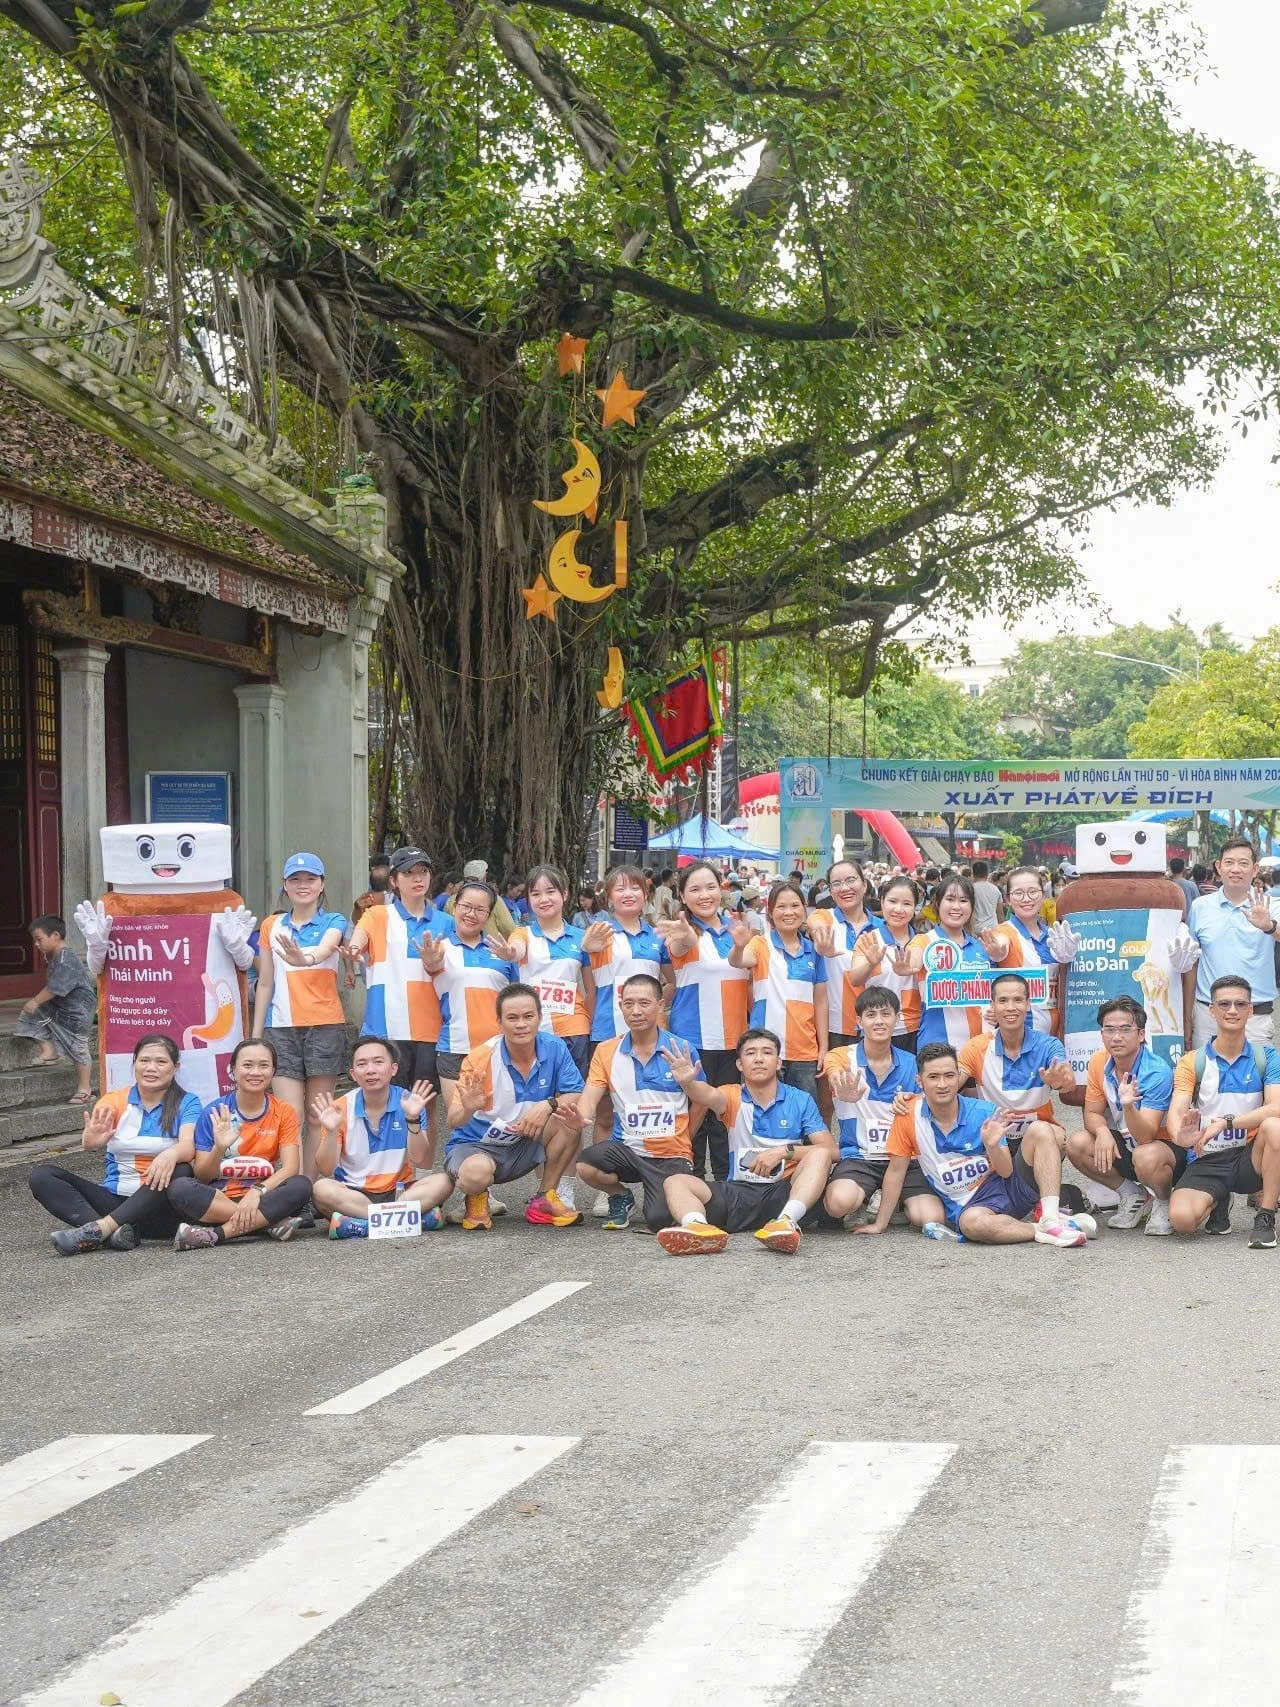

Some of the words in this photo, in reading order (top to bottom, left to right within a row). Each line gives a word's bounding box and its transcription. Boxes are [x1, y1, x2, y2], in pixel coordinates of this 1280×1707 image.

[862, 769, 896, 782] CHUNG
[899, 767, 918, 781] KẾT
[921, 767, 941, 782] GIẢI
[944, 769, 970, 785] CHẠY
[974, 768, 994, 782] BÁO
[1064, 768, 1080, 782] MỞ
[1083, 768, 1109, 785] RỘNG
[1112, 766, 1131, 782] LẦN
[1157, 770, 1169, 782] 50
[1192, 768, 1210, 781] HÒA
[1214, 768, 1237, 781] BÌNH
[1240, 769, 1262, 781] NĂM
[944, 785, 1014, 805] XUẤT
[1147, 786, 1213, 804] ĐÍCH
[794, 858, 804, 871] 71
[108, 938, 153, 961] Bình
[160, 937, 191, 965] Vị
[935, 945, 953, 969] 50
[1096, 957, 1128, 971] Đan
[110, 967, 131, 982] Thái
[135, 968, 172, 982] Minh
[932, 977, 958, 1000] DƯỢC
[961, 971, 991, 1000] PHẨM
[632, 1111, 673, 1127] 9774
[222, 1166, 273, 1179] 9780
[942, 1160, 988, 1186] 9786
[371, 1210, 419, 1228] 9770
